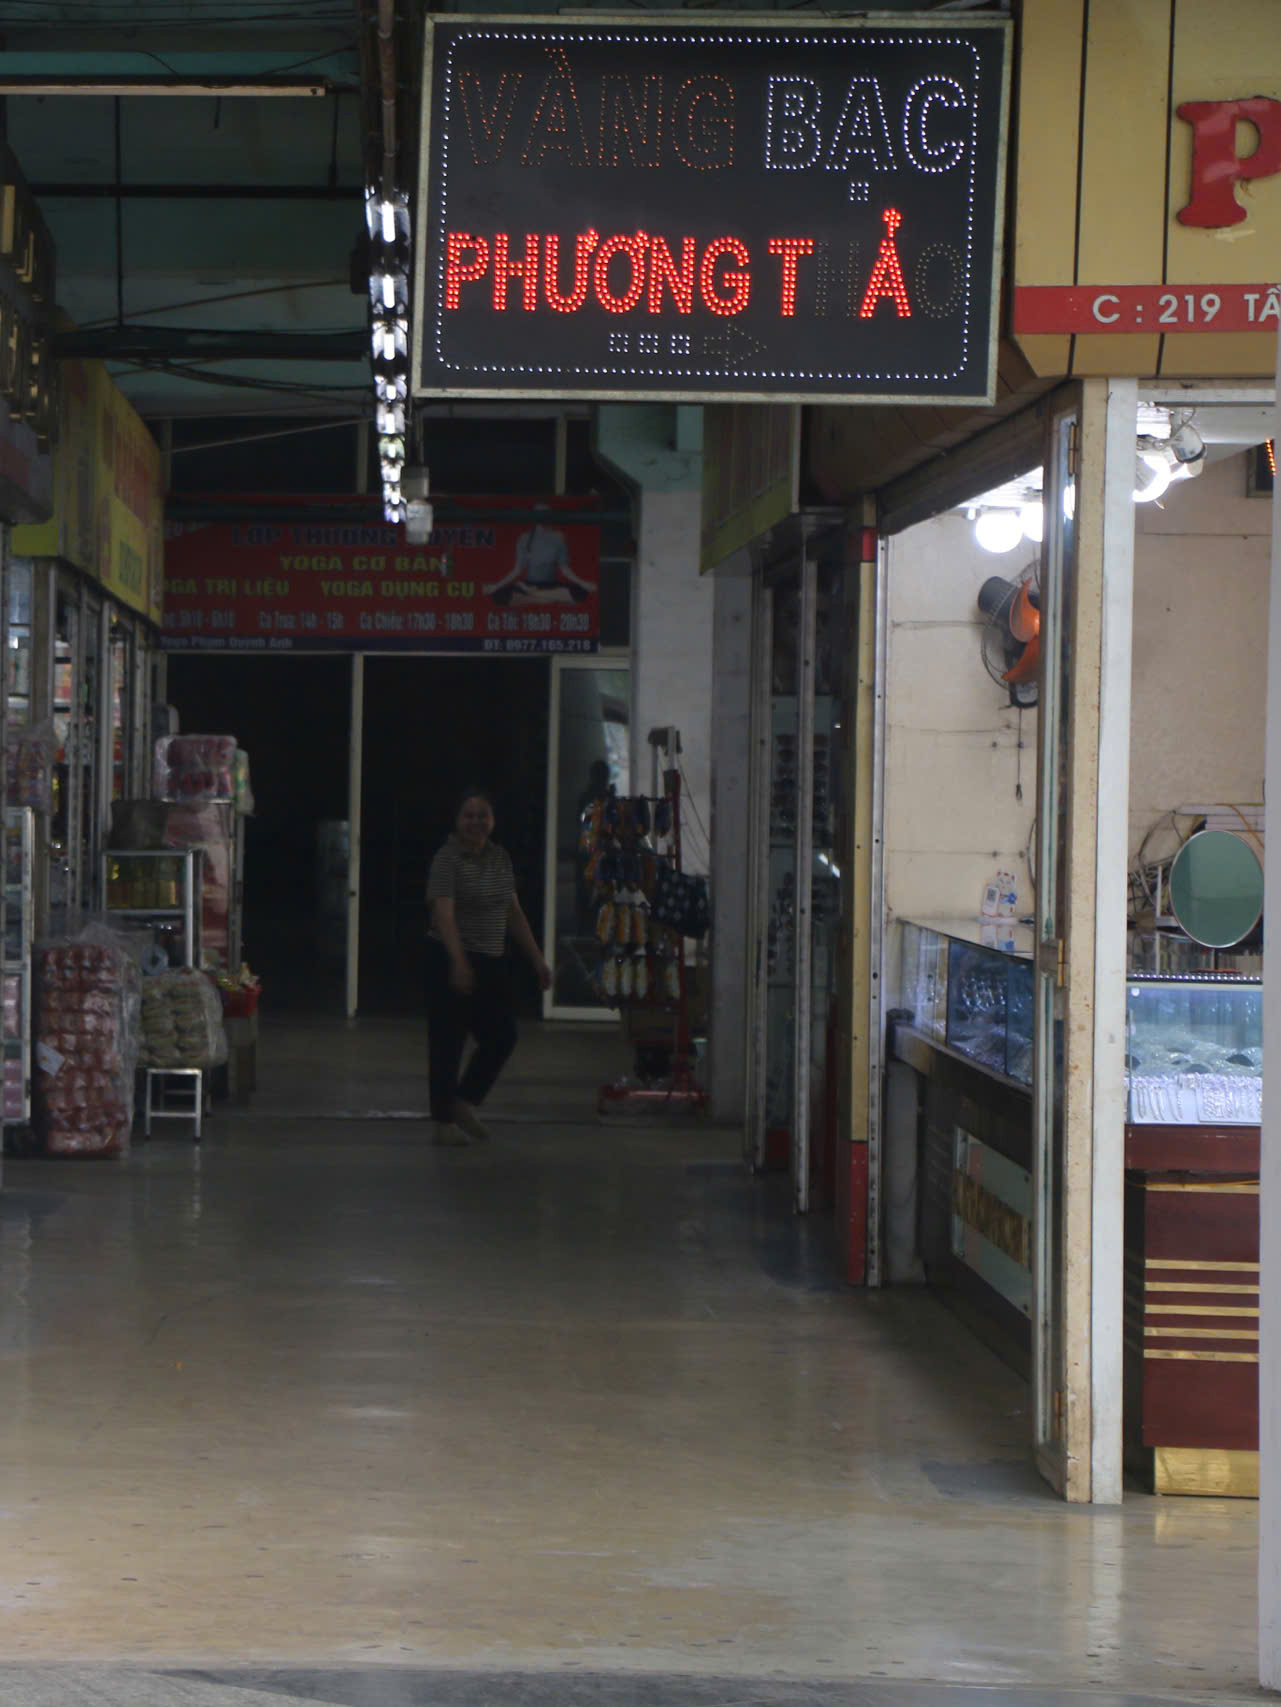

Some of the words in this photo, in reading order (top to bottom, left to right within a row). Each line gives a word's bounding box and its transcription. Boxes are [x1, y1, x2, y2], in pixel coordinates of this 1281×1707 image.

[457, 47, 736, 171] VÀNG
[762, 74, 968, 202] BẠC
[445, 229, 752, 317] PHƯƠNG
[1158, 294, 1221, 323] 219
[279, 555, 344, 571] YOGA
[320, 580, 374, 597] YOGA
